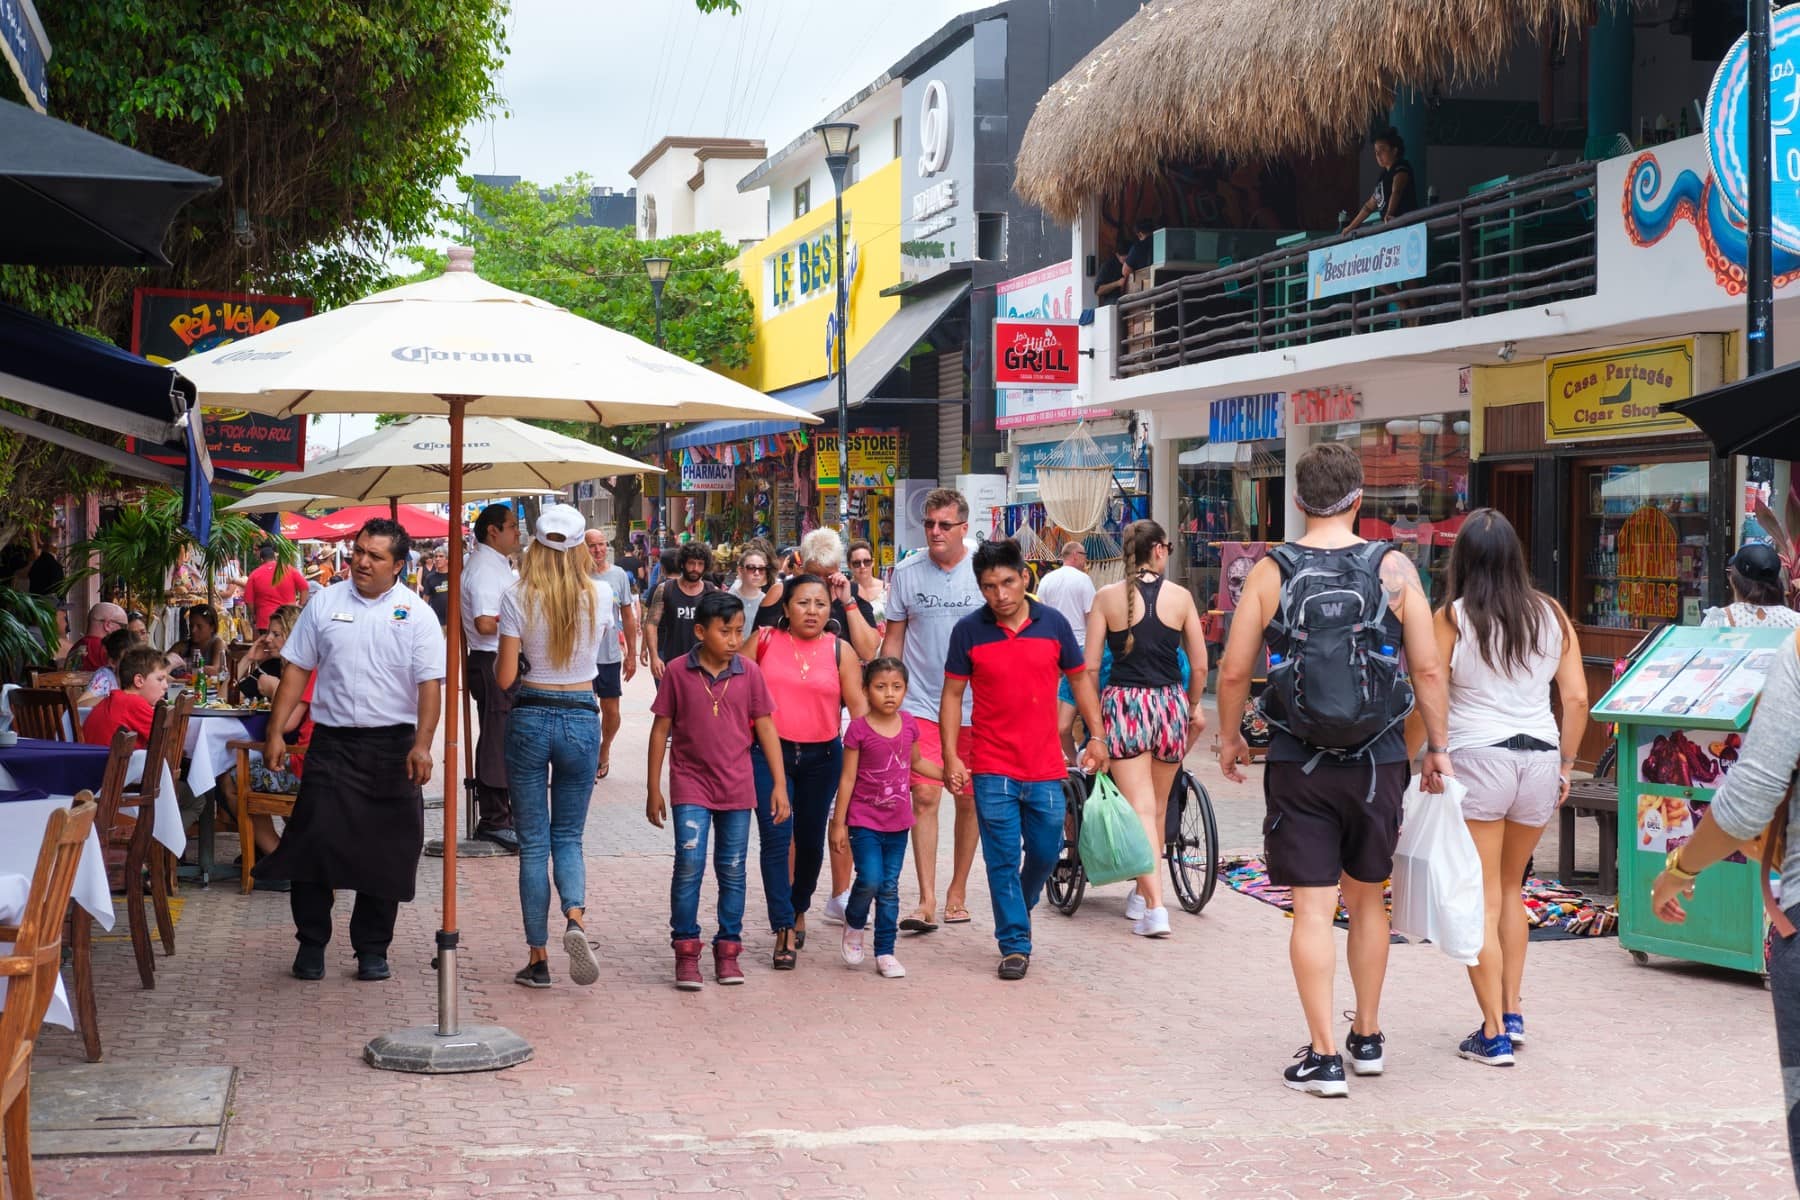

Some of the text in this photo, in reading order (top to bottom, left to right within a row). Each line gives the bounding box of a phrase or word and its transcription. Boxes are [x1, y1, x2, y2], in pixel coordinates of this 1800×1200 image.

[773, 222, 849, 307] LE BES
[1324, 259, 1347, 281] Best
[1347, 254, 1371, 276] view
[1372, 247, 1386, 272] of
[391, 346, 535, 364] Corona
[1014, 334, 1057, 356] Hijas
[1005, 348, 1070, 372] GRILL
[1563, 363, 1673, 399] Casa Partagás
[1574, 404, 1660, 424] Cigar Shop
[268, 427, 292, 442] ROLL
[413, 442, 490, 450] Corna
[683, 465, 733, 480] PHARMACY
[924, 594, 972, 608] Diesel
[1618, 581, 1678, 618] CIGARS
